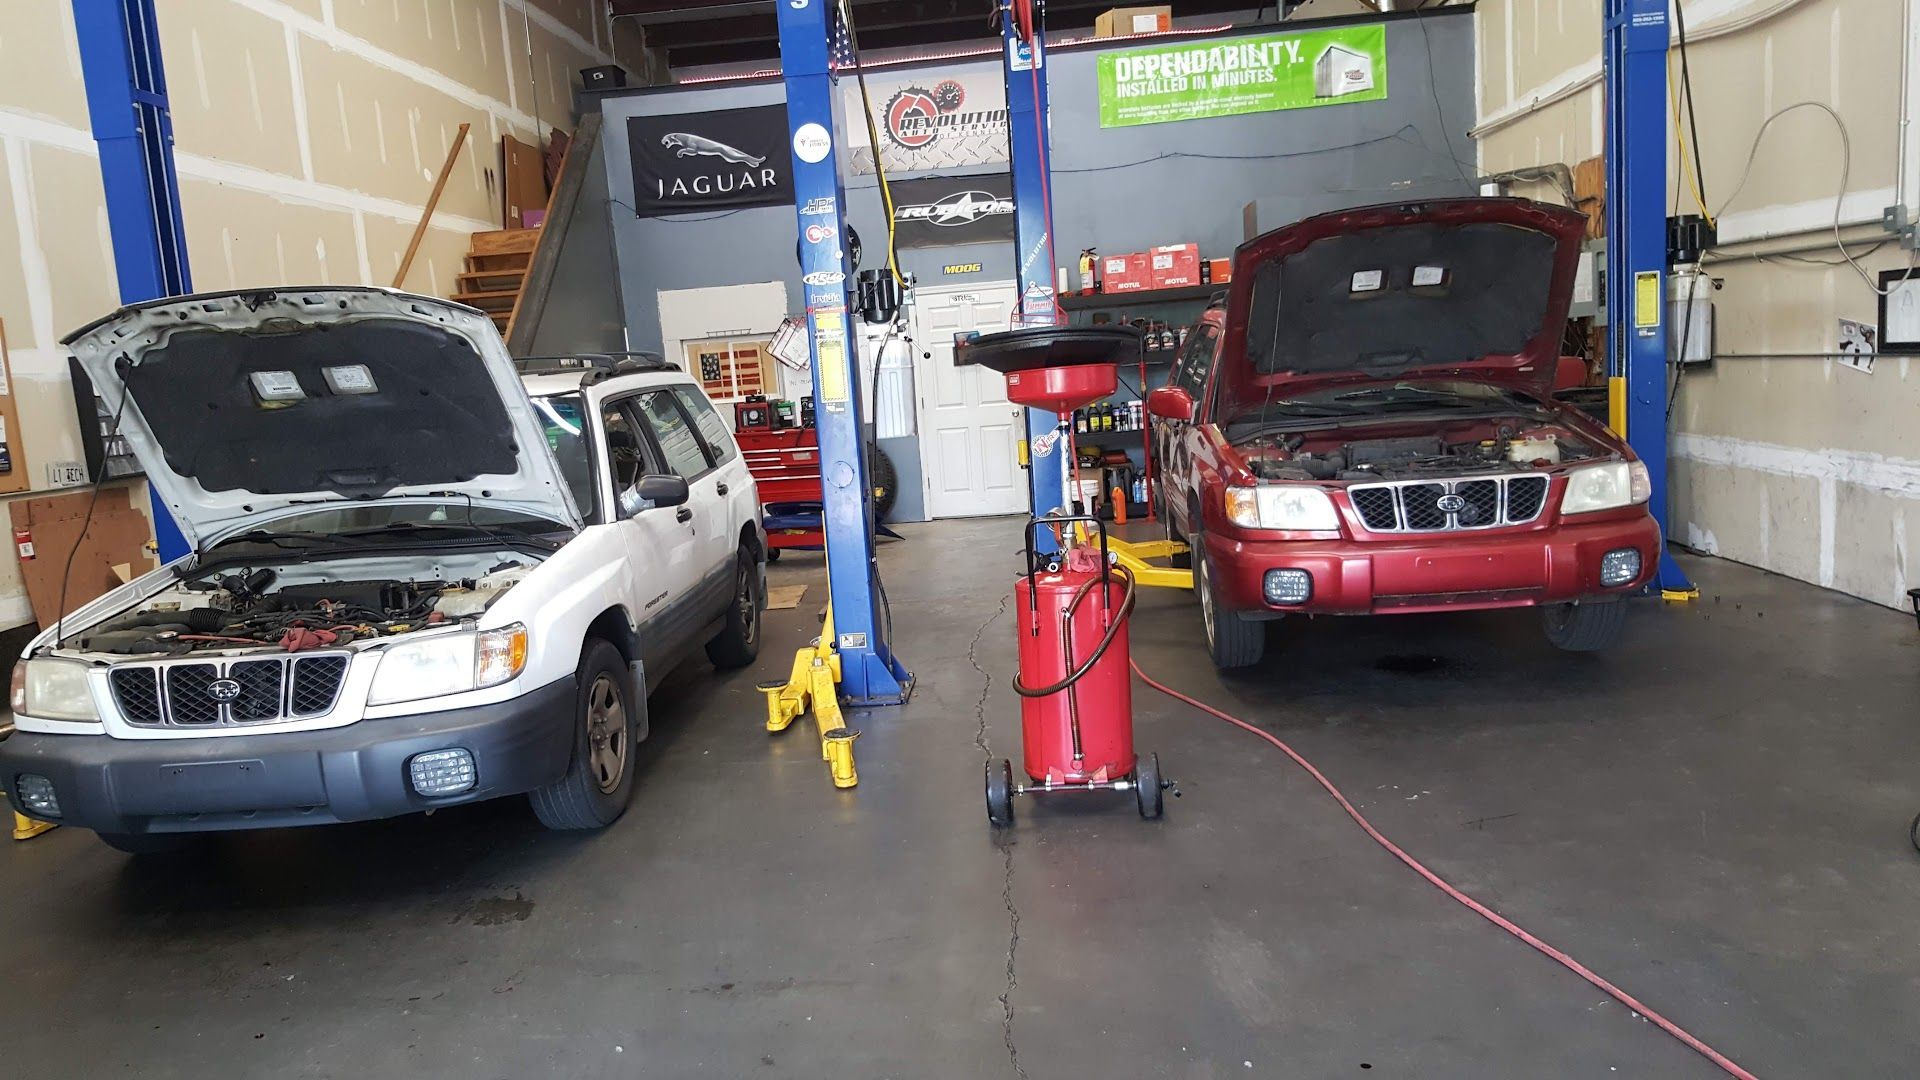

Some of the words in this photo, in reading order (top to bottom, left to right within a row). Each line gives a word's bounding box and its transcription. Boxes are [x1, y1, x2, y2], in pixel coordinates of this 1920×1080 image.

[1115, 40, 1305, 82] DEPENDABILITY.
[1116, 78, 1188, 98] INSTALLED
[1192, 76, 1207, 91] IN
[1211, 67, 1278, 89] MINUTES.
[899, 109, 1006, 131] REVOLUTIO
[900, 128, 939, 137] AUTO
[950, 121, 1007, 132] SERVIC
[958, 128, 1007, 137] KENNESA
[658, 168, 777, 200] JAGUAR
[944, 263, 981, 275] MOOG
[1117, 281, 1141, 290] MOTUL
[1164, 277, 1188, 286] MOTUL
